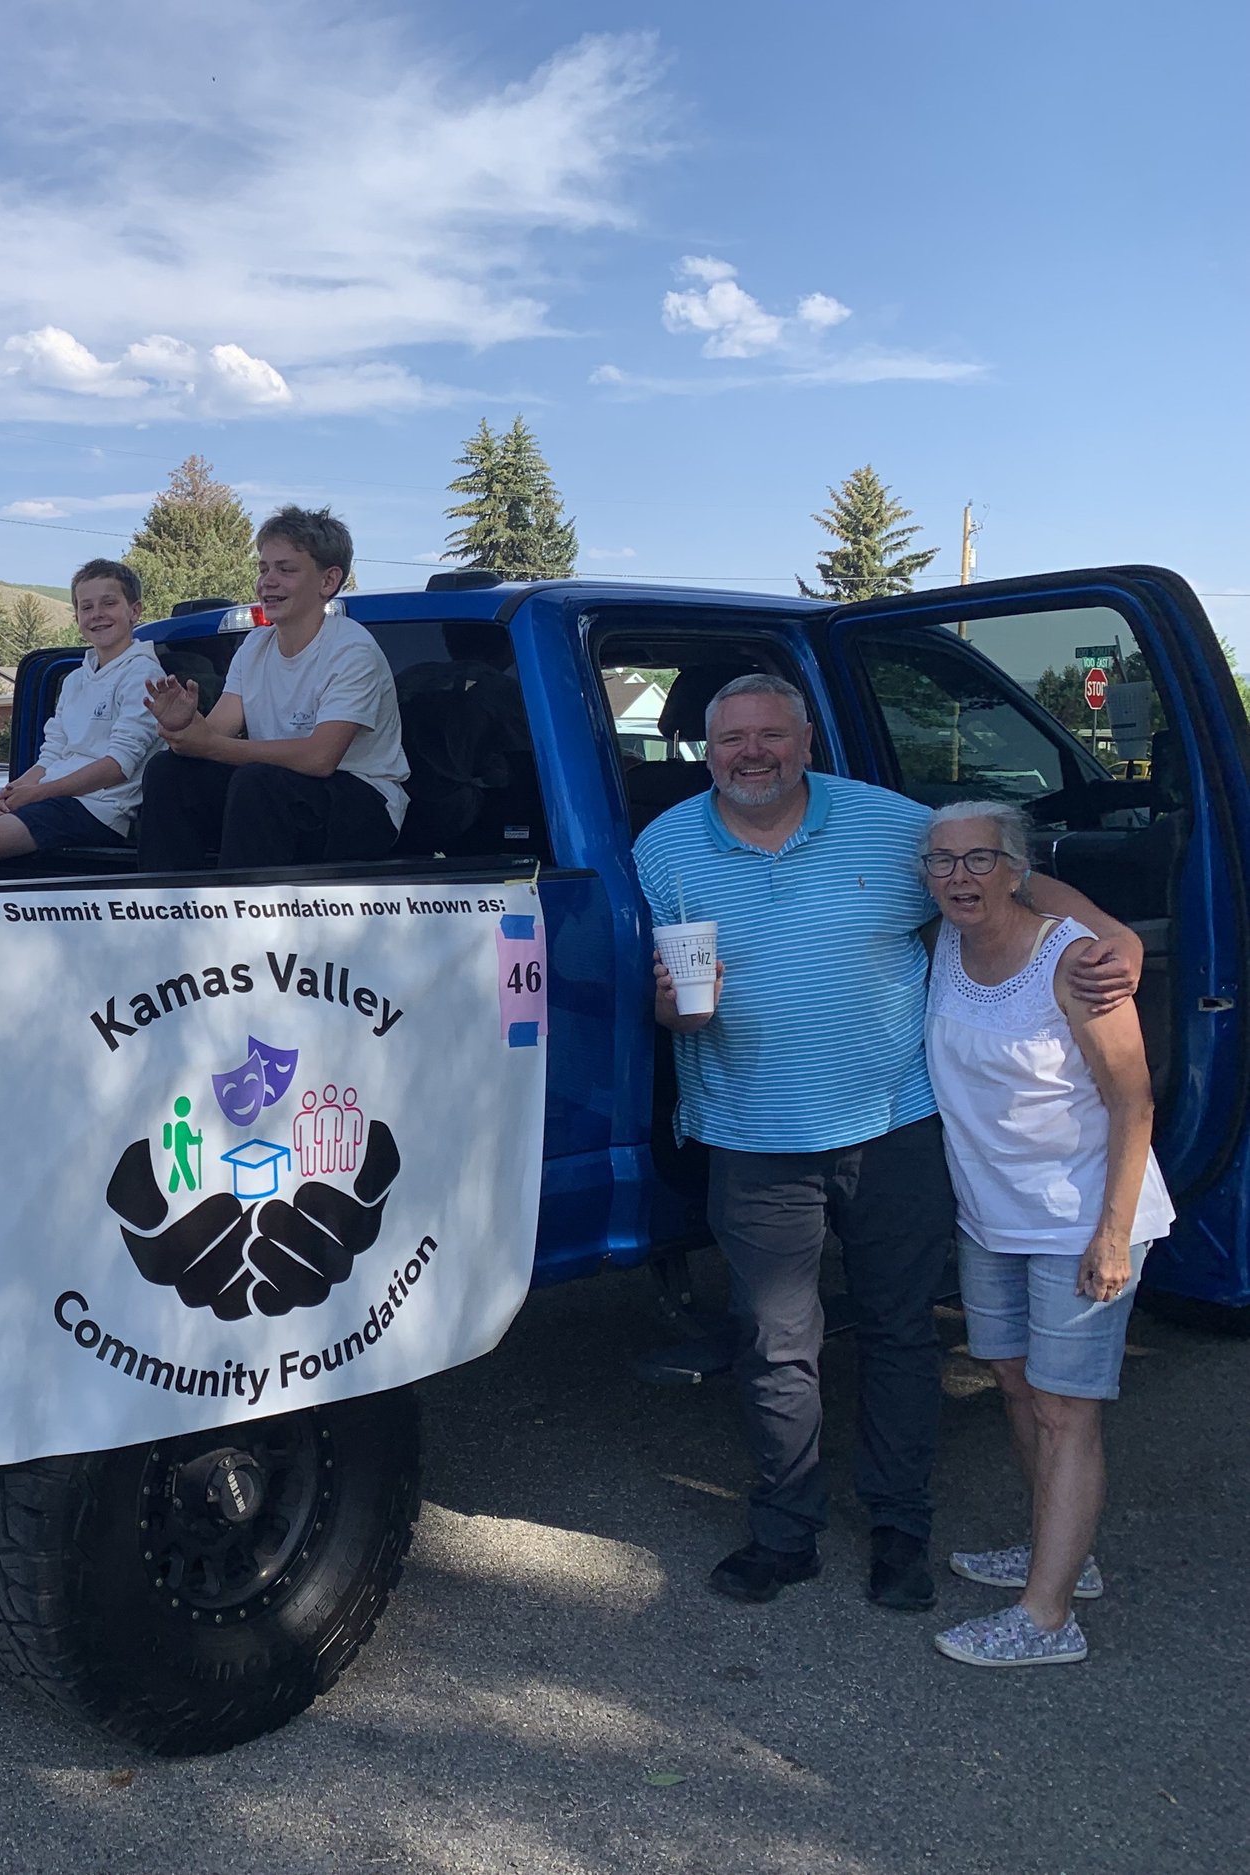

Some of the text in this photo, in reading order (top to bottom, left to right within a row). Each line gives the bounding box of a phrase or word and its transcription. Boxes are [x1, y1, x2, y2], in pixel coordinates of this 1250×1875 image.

[1087, 681, 1106, 696] STOP
[4, 901, 102, 923] Summit
[109, 900, 228, 921] Education
[234, 899, 354, 919] Foundation
[359, 900, 401, 916] now
[406, 897, 472, 915] known
[477, 898, 506, 912] as:
[507, 961, 542, 994] 46
[89, 951, 404, 1053] Kamas Valley
[54, 1235, 439, 1406] Community Foundation
